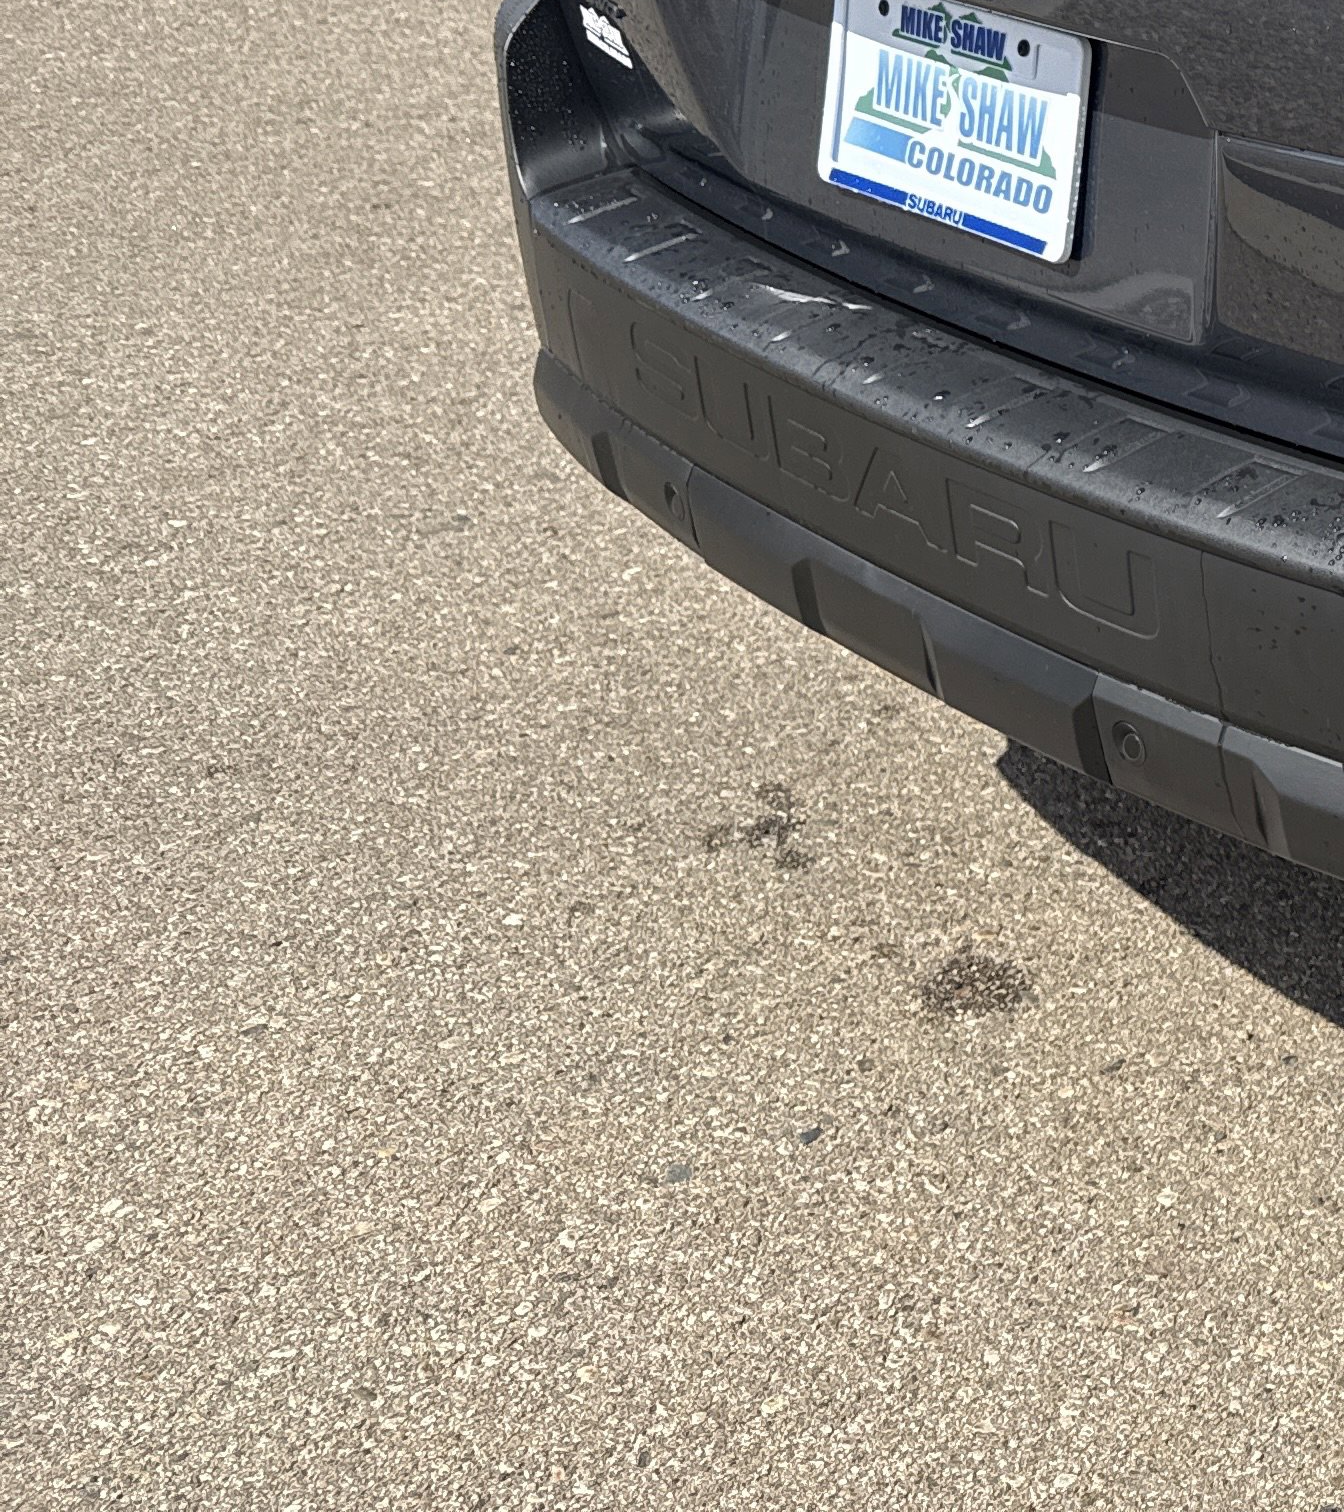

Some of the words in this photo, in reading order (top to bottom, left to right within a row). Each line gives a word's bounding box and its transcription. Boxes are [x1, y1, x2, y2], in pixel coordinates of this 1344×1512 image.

[900, 4, 946, 43] MIKE
[950, 18, 1008, 62] SHAW
[875, 48, 948, 127] MIKE
[958, 76, 1049, 160] SHAW
[906, 139, 1054, 215] COLORADO
[907, 194, 962, 225] SUBARU
[630, 321, 1161, 641] SUBARU
